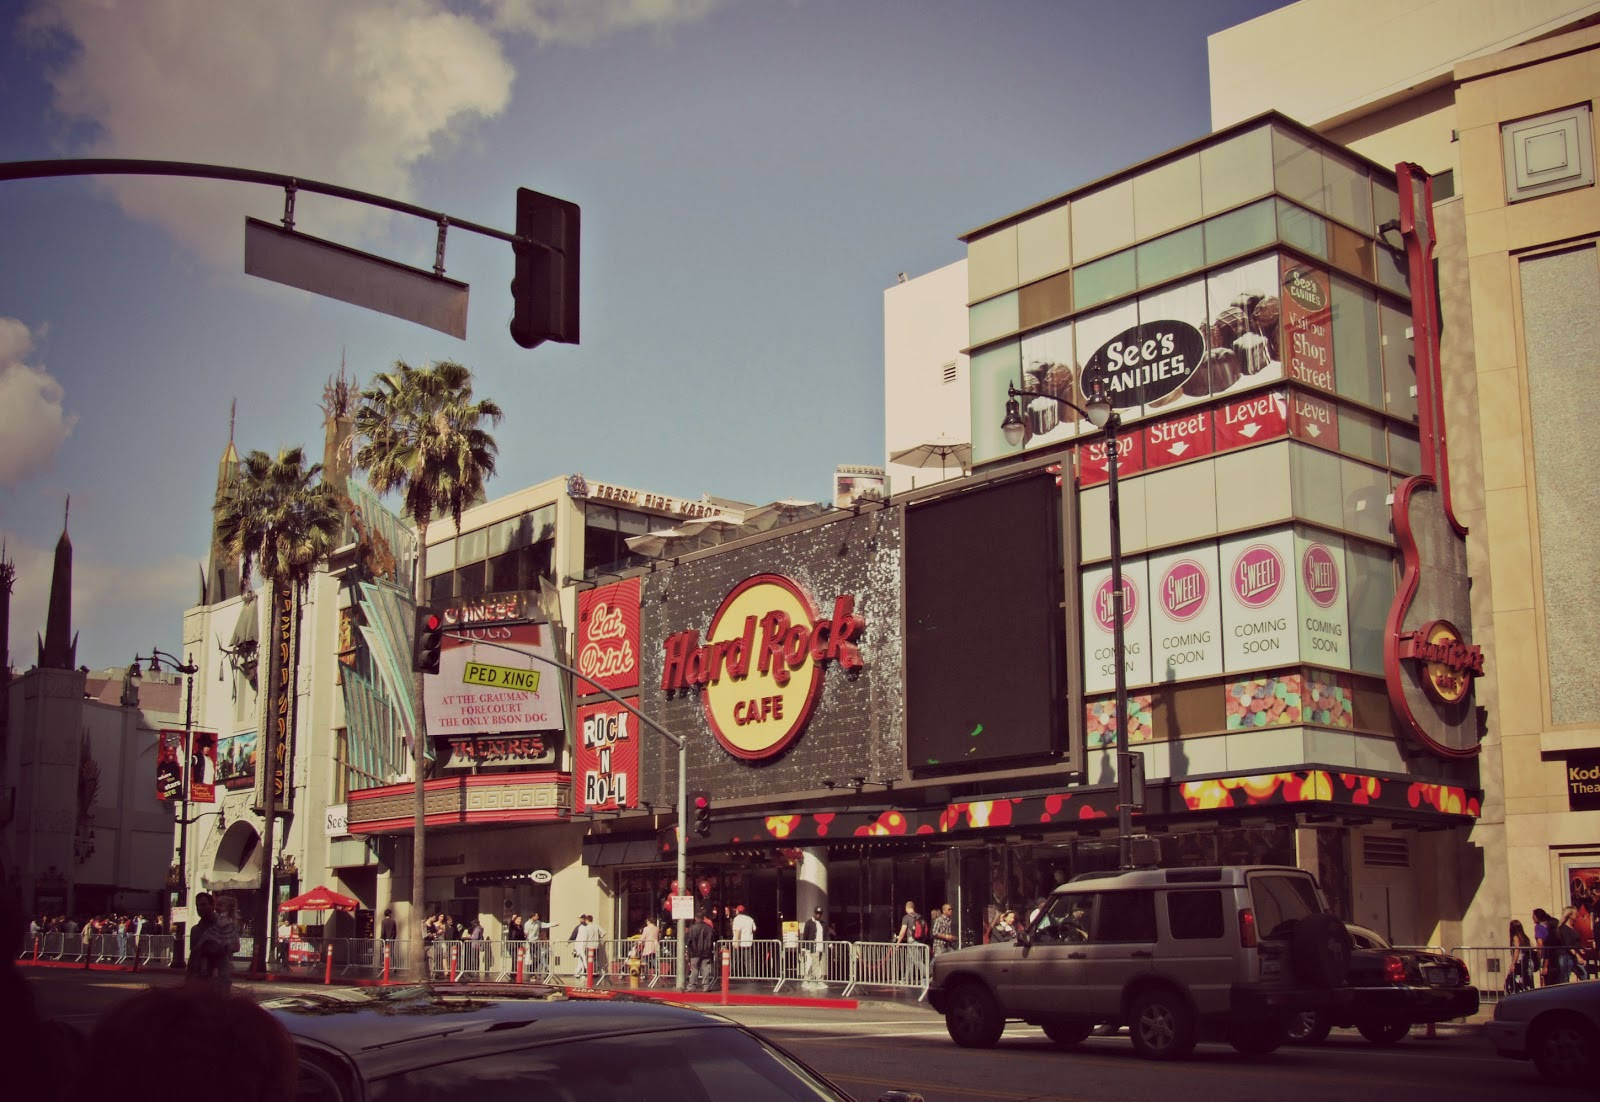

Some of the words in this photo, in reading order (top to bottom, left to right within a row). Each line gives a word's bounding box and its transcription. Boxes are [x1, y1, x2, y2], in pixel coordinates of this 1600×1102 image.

[1293, 271, 1317, 294] See's
[1107, 333, 1174, 372] See's
[1293, 332, 1327, 366] Shop
[1103, 354, 1185, 393] ANDIES
[1291, 358, 1332, 391] Street
[1151, 413, 1206, 444] Street
[1225, 392, 1276, 425] Level
[1295, 399, 1330, 424] Level
[1241, 557, 1275, 597] SWEET!
[1168, 572, 1201, 610] SWEET!
[1101, 586, 1132, 622] SWT!
[1234, 618, 1287, 638] COMING
[1305, 617, 1343, 636] COMING
[661, 615, 758, 691] Hard
[758, 594, 865, 687] Rock
[1094, 642, 1141, 661] CONG
[1162, 630, 1211, 650] COMING
[1243, 638, 1280, 655] SOON
[1312, 637, 1338, 653] SOON
[580, 639, 634, 679] Drink
[1101, 660, 1134, 677] SON
[1169, 650, 1205, 666] SOON
[469, 666, 497, 683] PED
[502, 670, 534, 688] XING
[442, 695, 455, 705] AT
[457, 694, 475, 705] THE
[461, 703, 522, 715] FORECOURT
[733, 695, 783, 726] CAFE
[439, 717, 459, 728] THE
[462, 715, 490, 727] ONLY
[492, 713, 521, 725] BISON
[525, 712, 548, 724] DOG
[584, 713, 629, 749] ROCK
[450, 738, 545, 760] THEATRES
[1569, 765, 1600, 781] Kod
[586, 771, 626, 805] ROLL
